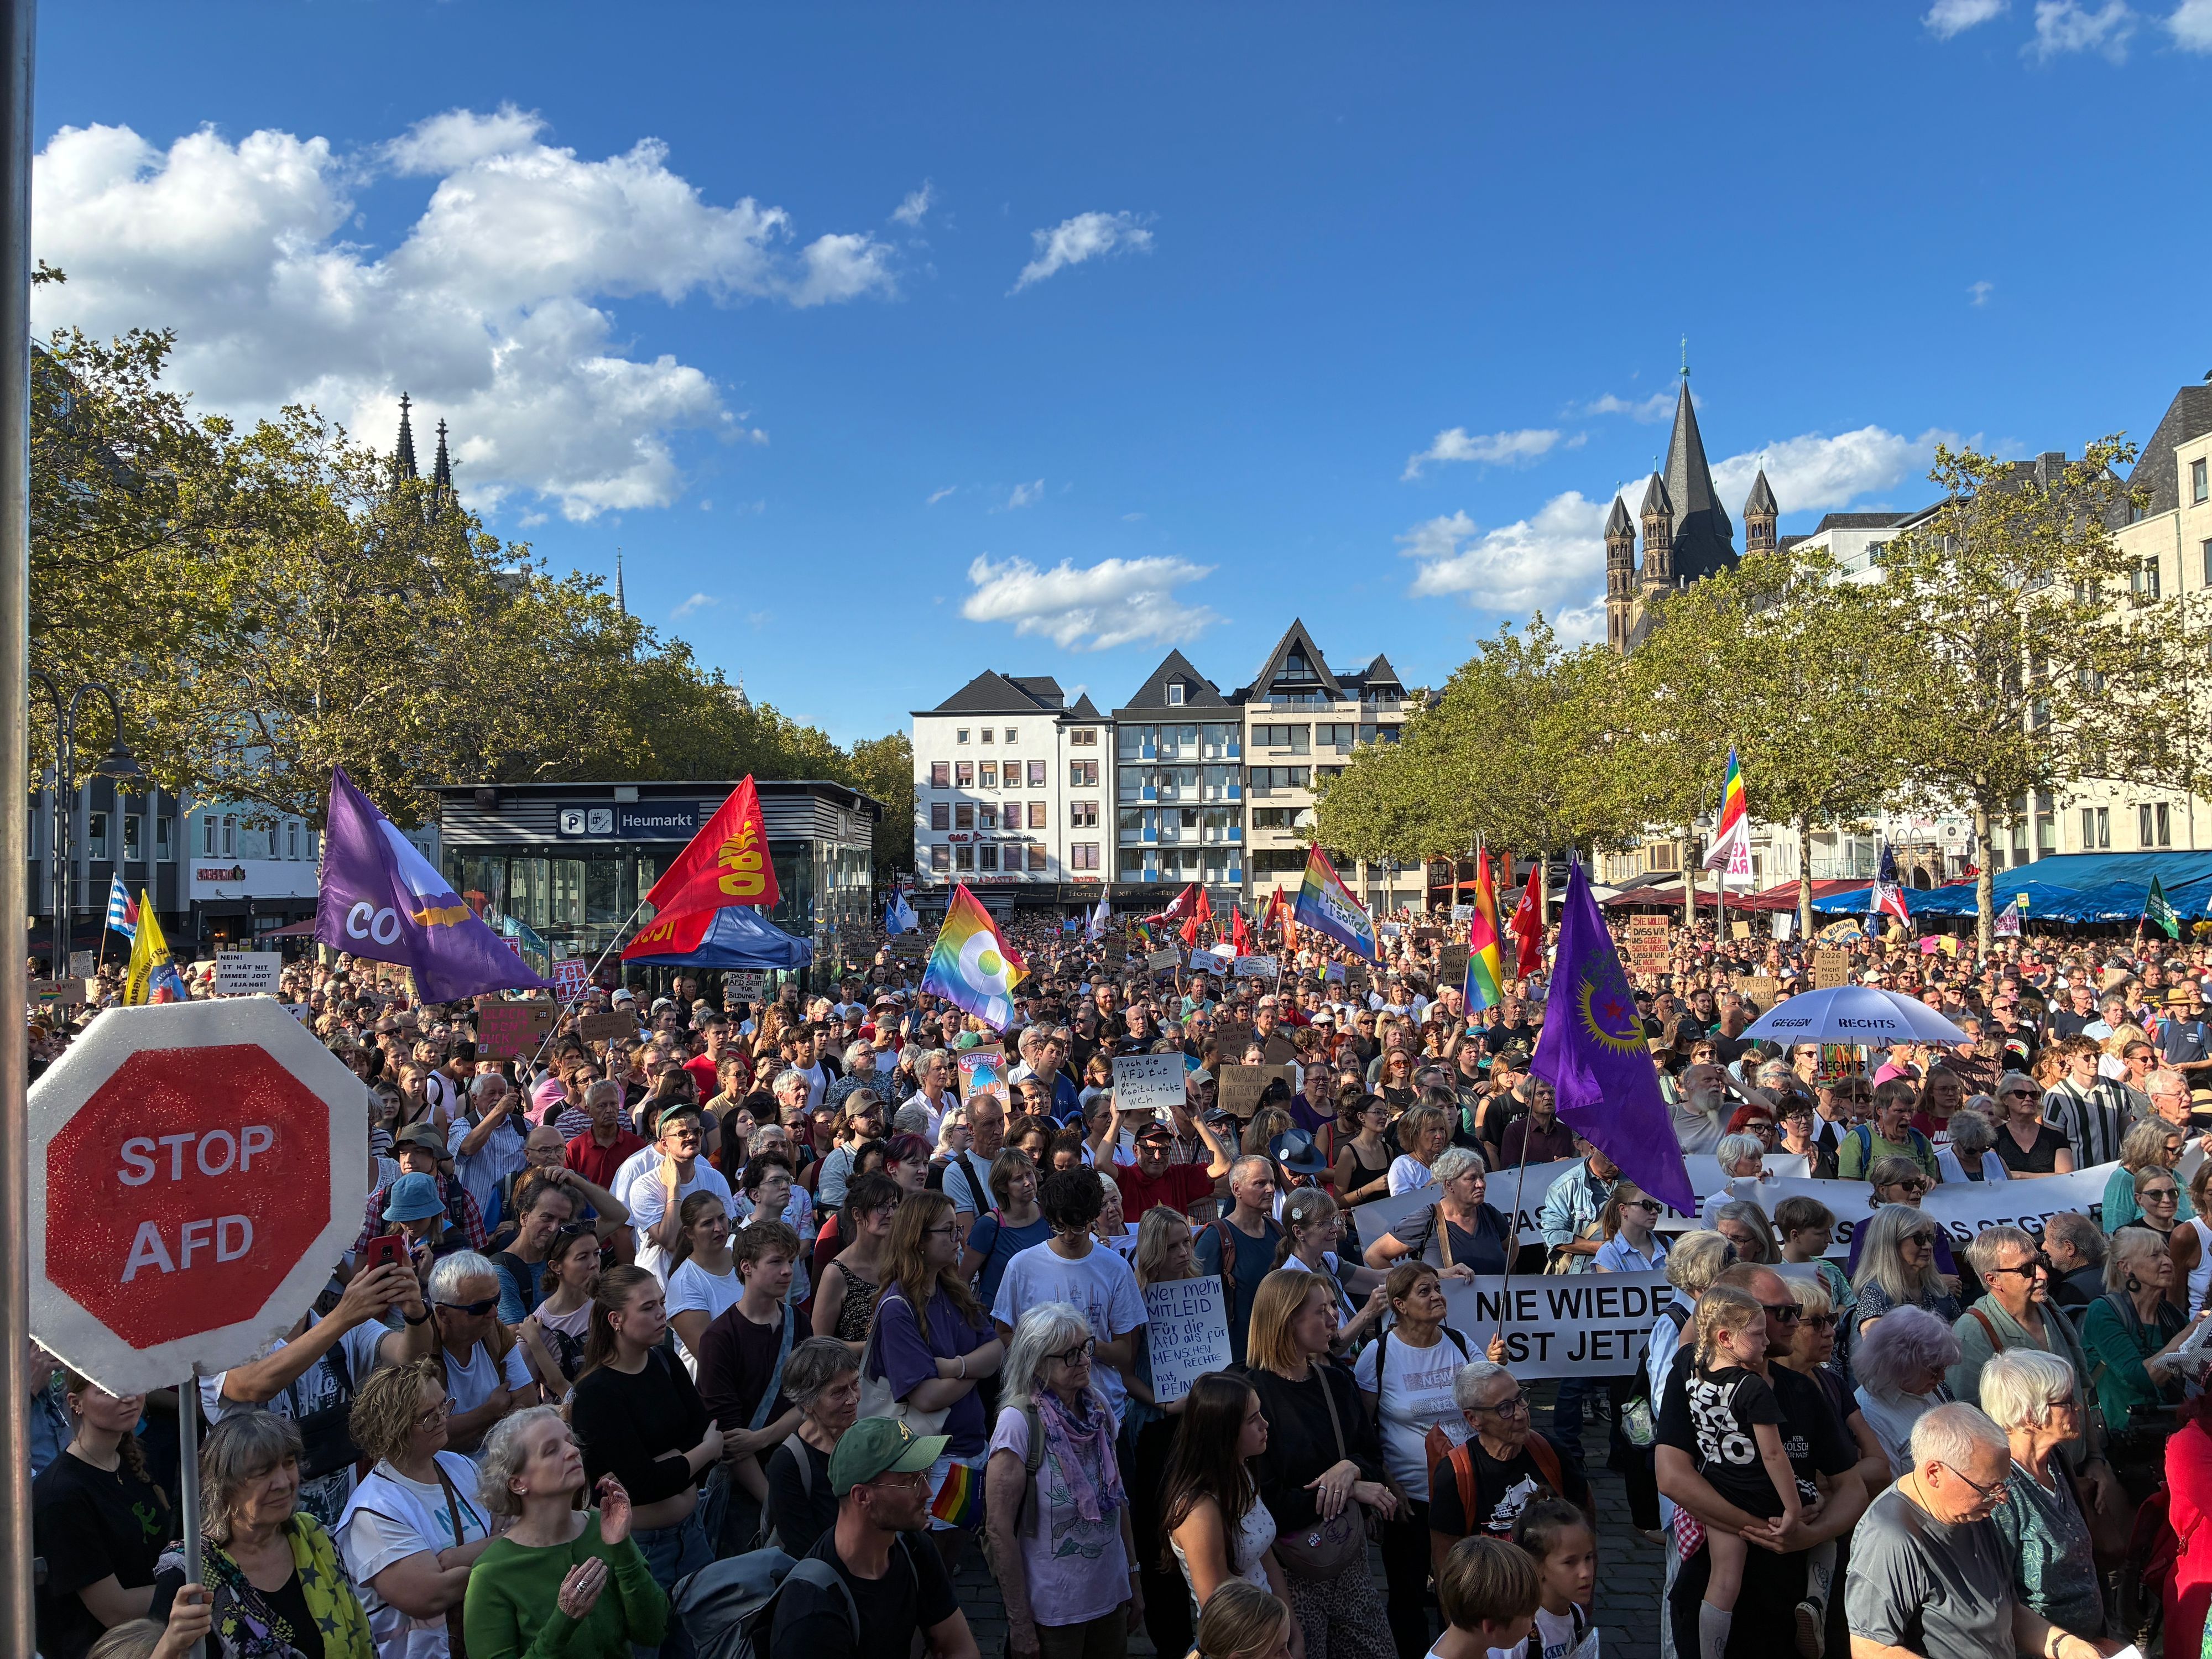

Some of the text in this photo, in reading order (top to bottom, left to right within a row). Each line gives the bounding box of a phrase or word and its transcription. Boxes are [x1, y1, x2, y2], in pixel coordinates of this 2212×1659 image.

[623, 813, 692, 826] Heumarkt
[978, 876, 1019, 884] APOSTEL
[1633, 916, 1667, 925] SIE WOLLEN
[1827, 921, 1856, 936] BLAUWAL
[1653, 926, 1666, 935] WIR
[1443, 948, 1460, 957] HÖRT
[555, 965, 586, 982] FCK
[557, 979, 588, 997] NZS
[1752, 991, 1774, 999] KACKEN
[1772, 1019, 1896, 1029] GEGEN RECHTS
[960, 1055, 998, 1069] SCHEISSE
[1118, 1059, 1141, 1068] Auch
[1818, 1061, 1866, 1072] RECHTS
[1120, 1067, 1167, 1081] AFD tut
[1225, 1067, 1269, 1083] NAZIS
[1159, 1082, 1180, 1092] nicht
[1222, 1084, 1250, 1097] HATTEN
[117, 1125, 274, 1186] STOP
[121, 1214, 254, 1283] AFD
[1145, 1279, 1221, 1304] Wer mehr
[1147, 1298, 1211, 1321] MITLEID
[1477, 1285, 1673, 1322] NIE WIEDE
[1150, 1319, 1204, 1335] Für die
[1154, 1333, 1178, 1350] AfD
[1184, 1333, 1202, 1343] als
[1506, 1331, 1555, 1363] ST
[1152, 1345, 1211, 1365] MENSCHEN
[1183, 1353, 1222, 1369] RECHTE
[1156, 1371, 1176, 1382] hat,
[1422, 1370, 1452, 1386] NEW
[1162, 1379, 1195, 1396] PEIN
[1697, 1430, 1755, 1465] GO
